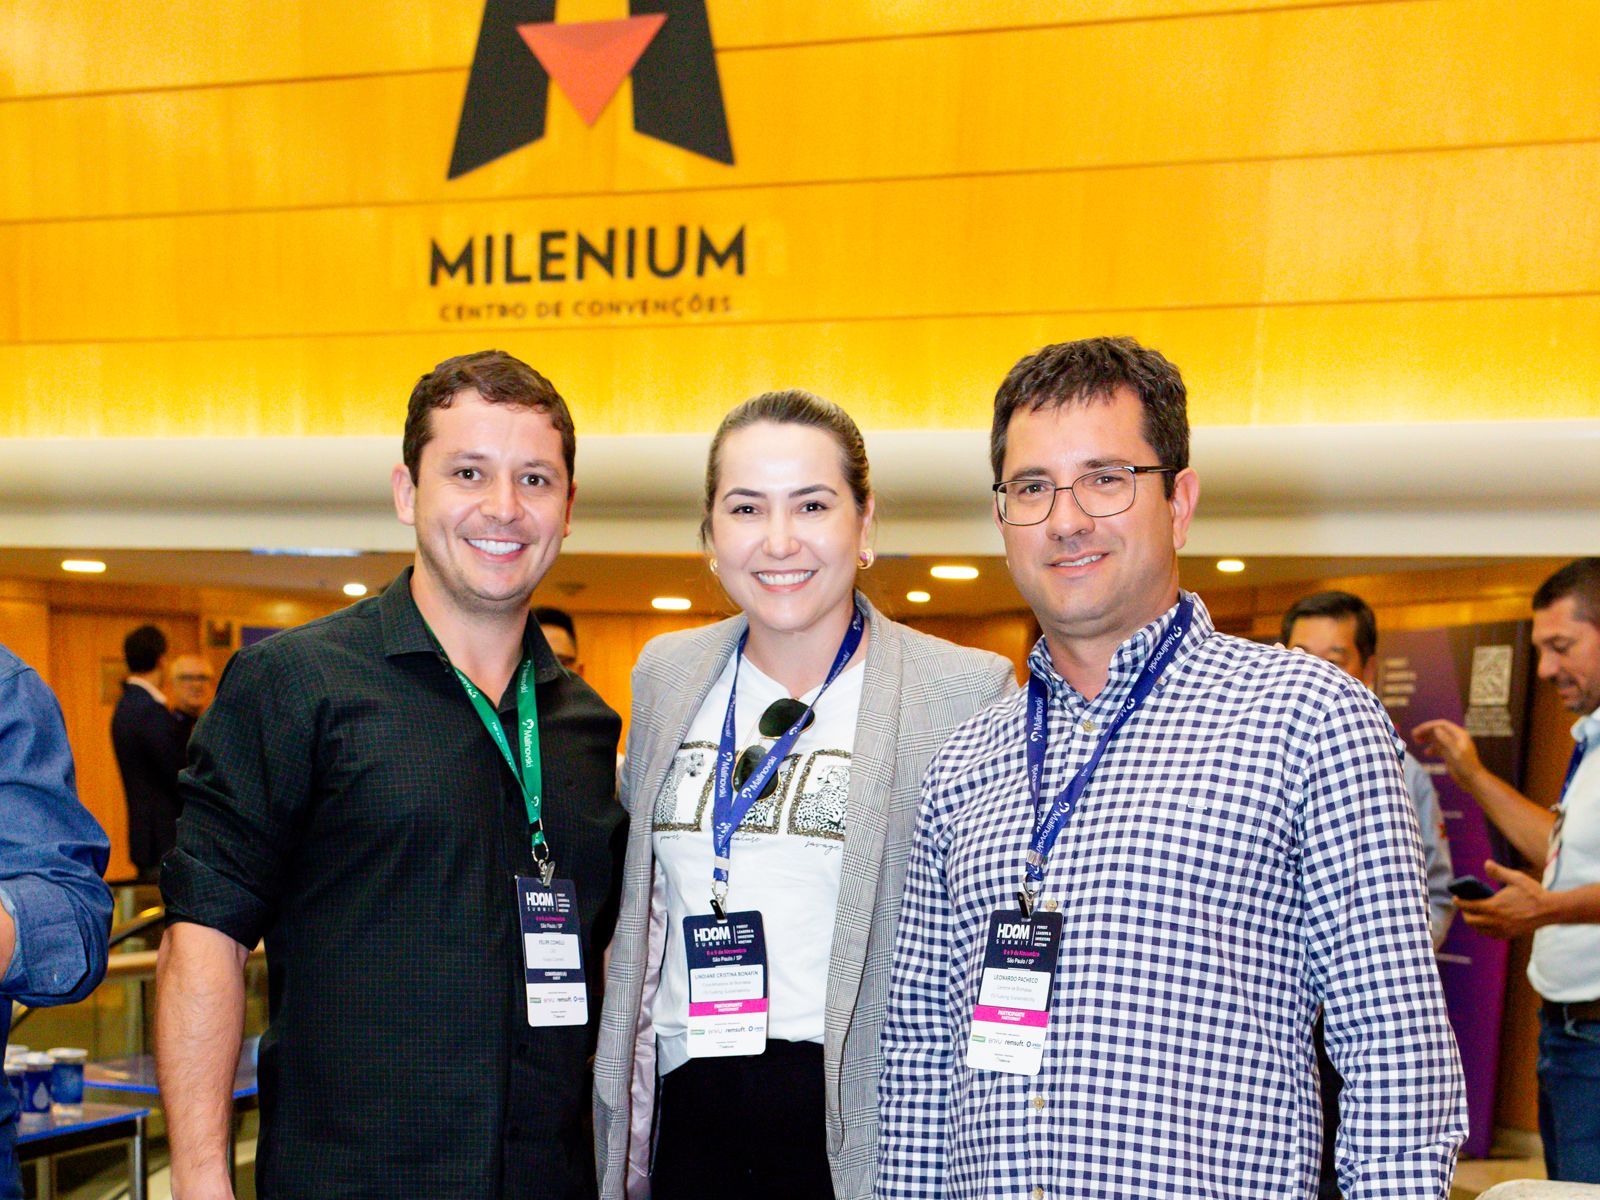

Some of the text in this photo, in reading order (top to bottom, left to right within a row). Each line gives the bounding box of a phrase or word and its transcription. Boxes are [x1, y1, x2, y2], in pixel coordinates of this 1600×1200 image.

[430, 224, 746, 287] MILENIUM
[438, 293, 732, 322] CENTRO DE CONVENÇÕES
[1149, 633, 1176, 674] Malinovski
[1033, 696, 1044, 731] Malinovski
[522, 729, 533, 768] Malinovski
[719, 758, 728, 798] Malinovski
[750, 755, 777, 790] Malinovski
[1036, 808, 1062, 854] Malinovski
[526, 892, 554, 906] HDOM
[694, 926, 731, 942] HDOM
[996, 923, 1030, 940] HDOM
